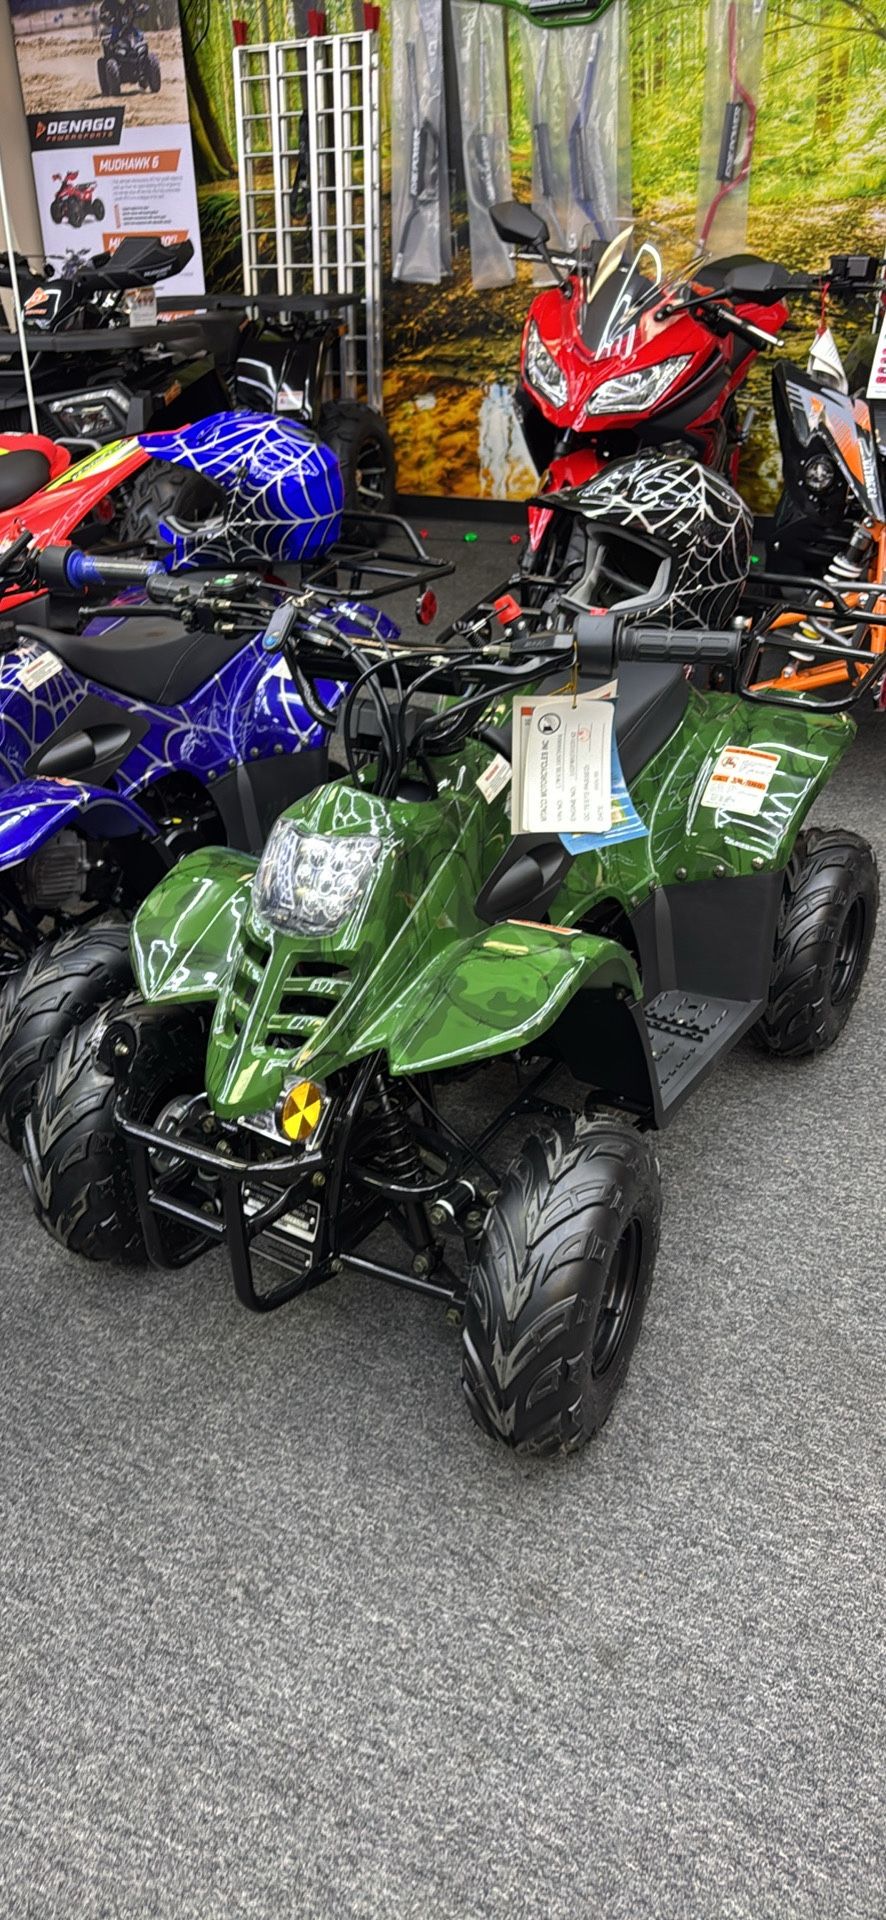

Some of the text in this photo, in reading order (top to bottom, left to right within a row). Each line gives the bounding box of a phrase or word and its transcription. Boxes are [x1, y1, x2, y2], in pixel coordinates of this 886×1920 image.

[47, 117, 116, 135] DENAGO
[99, 155, 160, 172] MUDHAWK 6
